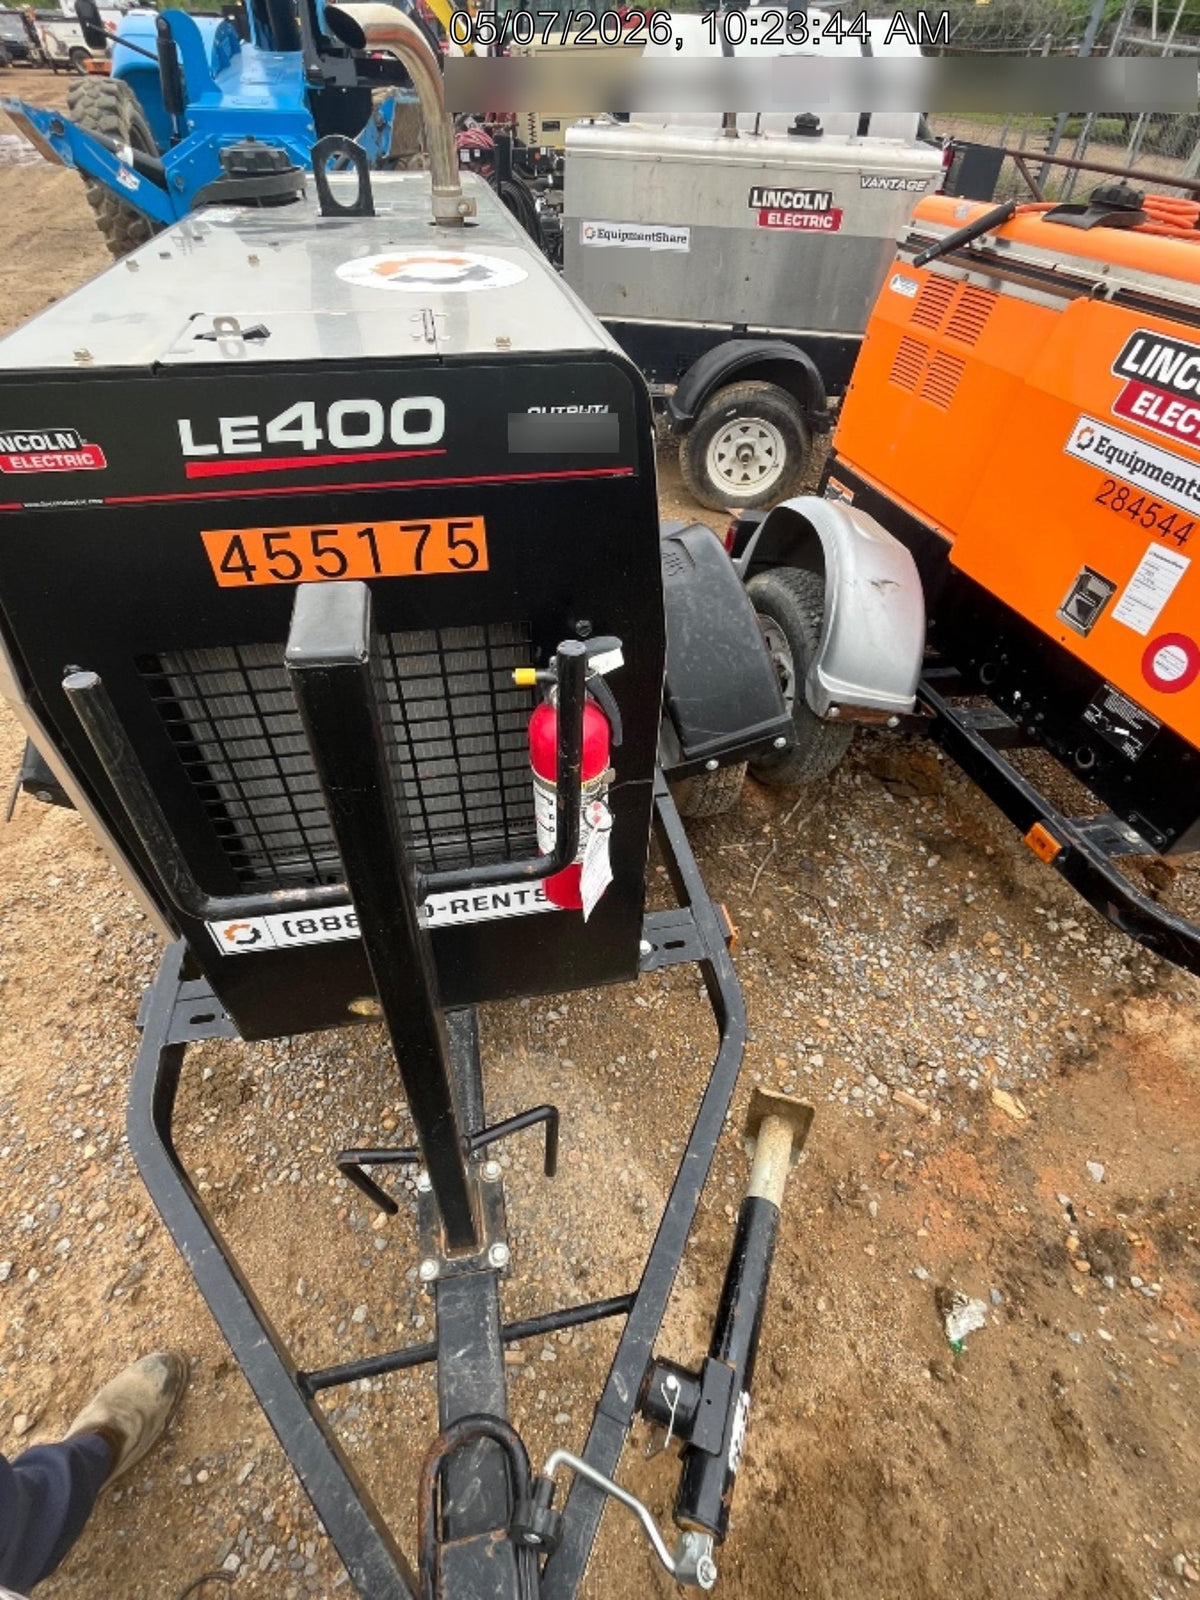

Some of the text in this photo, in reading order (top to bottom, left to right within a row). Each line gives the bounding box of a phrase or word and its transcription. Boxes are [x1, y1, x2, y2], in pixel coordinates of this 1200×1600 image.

[750, 188, 830, 210] LINCOLN
[860, 177, 929, 192] VANTAGE
[596, 228, 688, 244] EquipmentShare
[766, 212, 834, 229] ELECTRIC
[1121, 338, 1200, 396] LINC
[177, 396, 446, 456] LE400
[1130, 389, 1200, 439] ELEC
[9, 453, 95, 469] ELECTRIC
[1095, 479, 1195, 547] 284544
[220, 522, 479, 582] 455175
